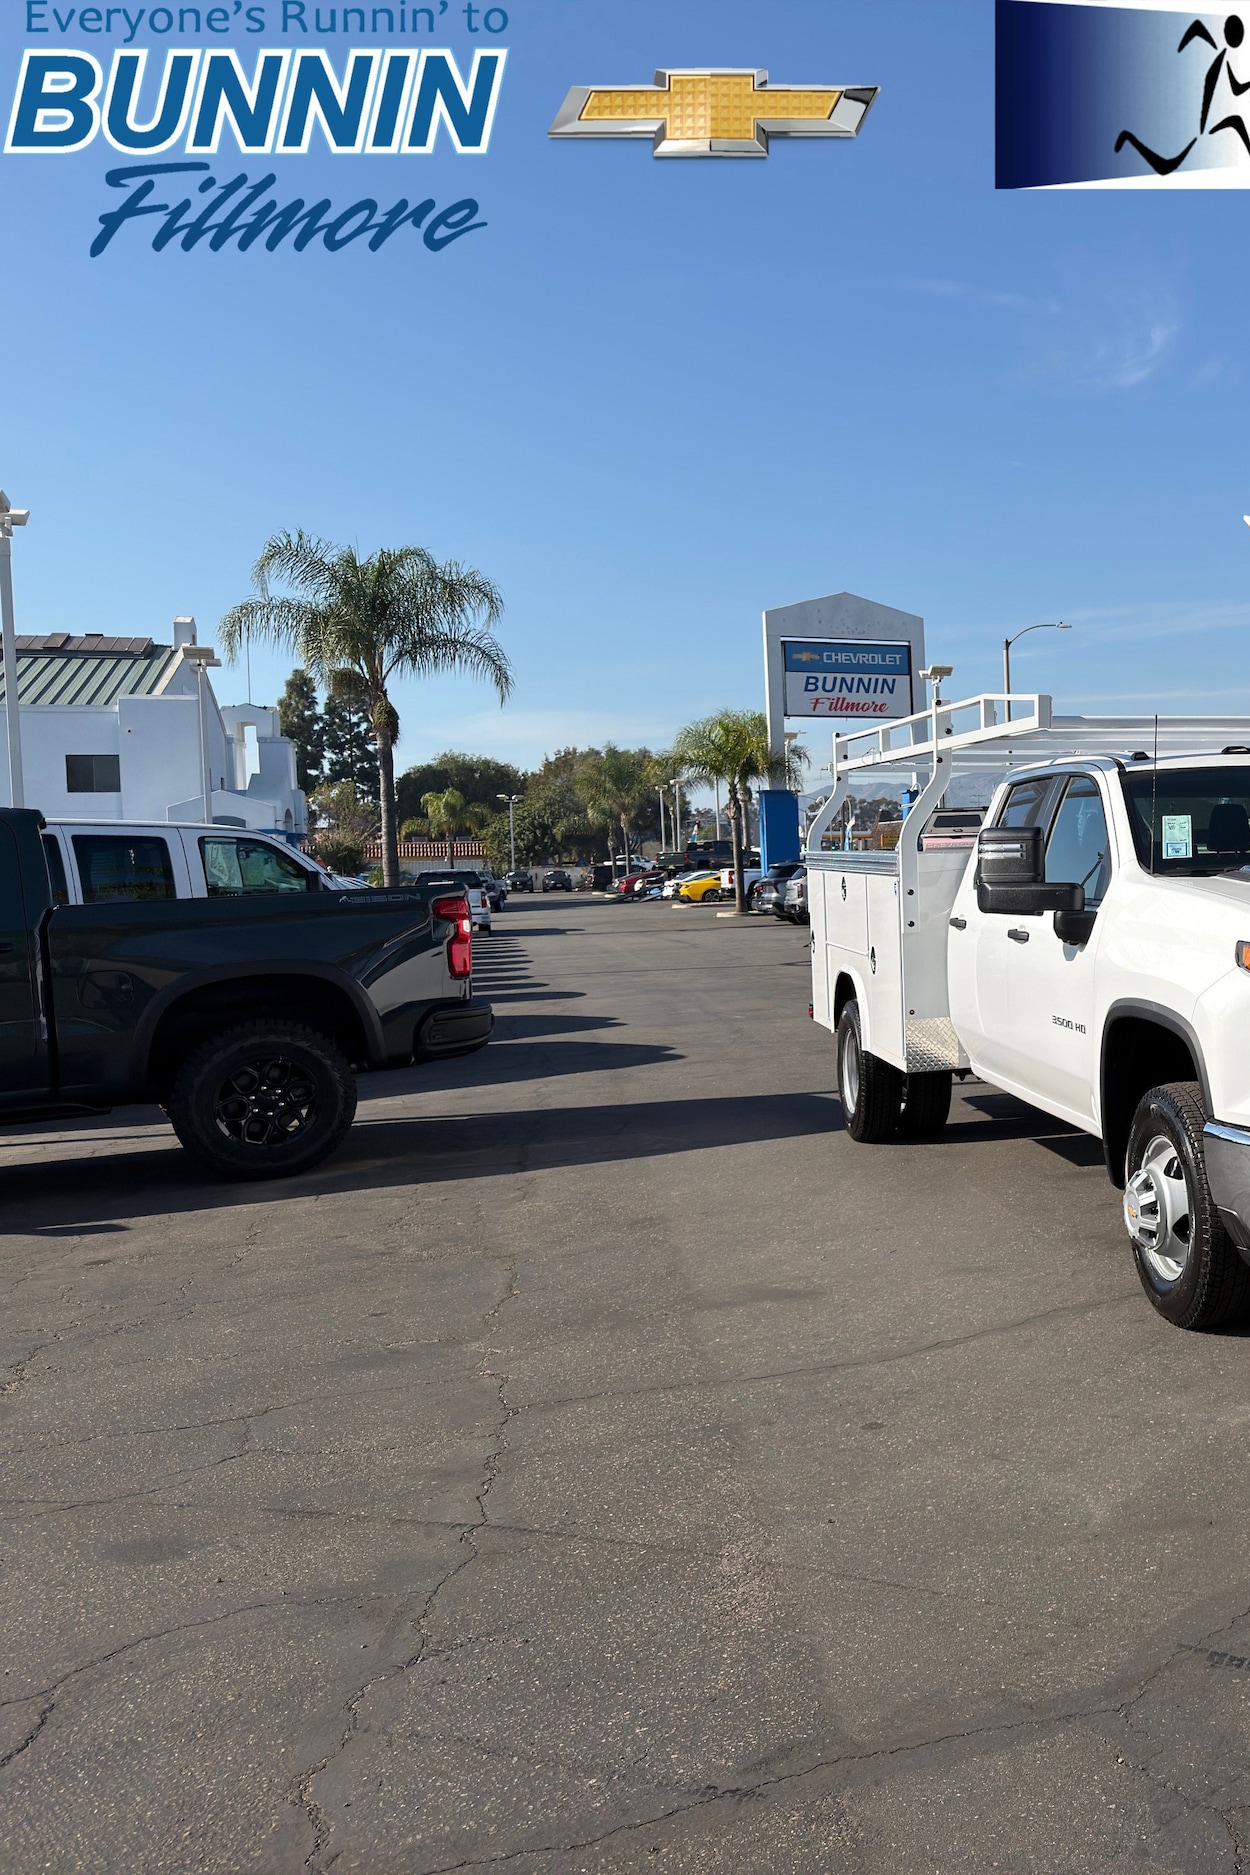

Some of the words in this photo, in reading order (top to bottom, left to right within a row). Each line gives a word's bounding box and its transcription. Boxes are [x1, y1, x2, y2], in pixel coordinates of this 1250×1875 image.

[823, 652, 902, 665] CHEVROLET
[804, 676, 896, 694] BUNNIN
[809, 697, 889, 713] Fillmore
[350, 893, 421, 904] BISON
[1052, 1014, 1073, 1030] 3500
[1075, 1022, 1086, 1034] HD
